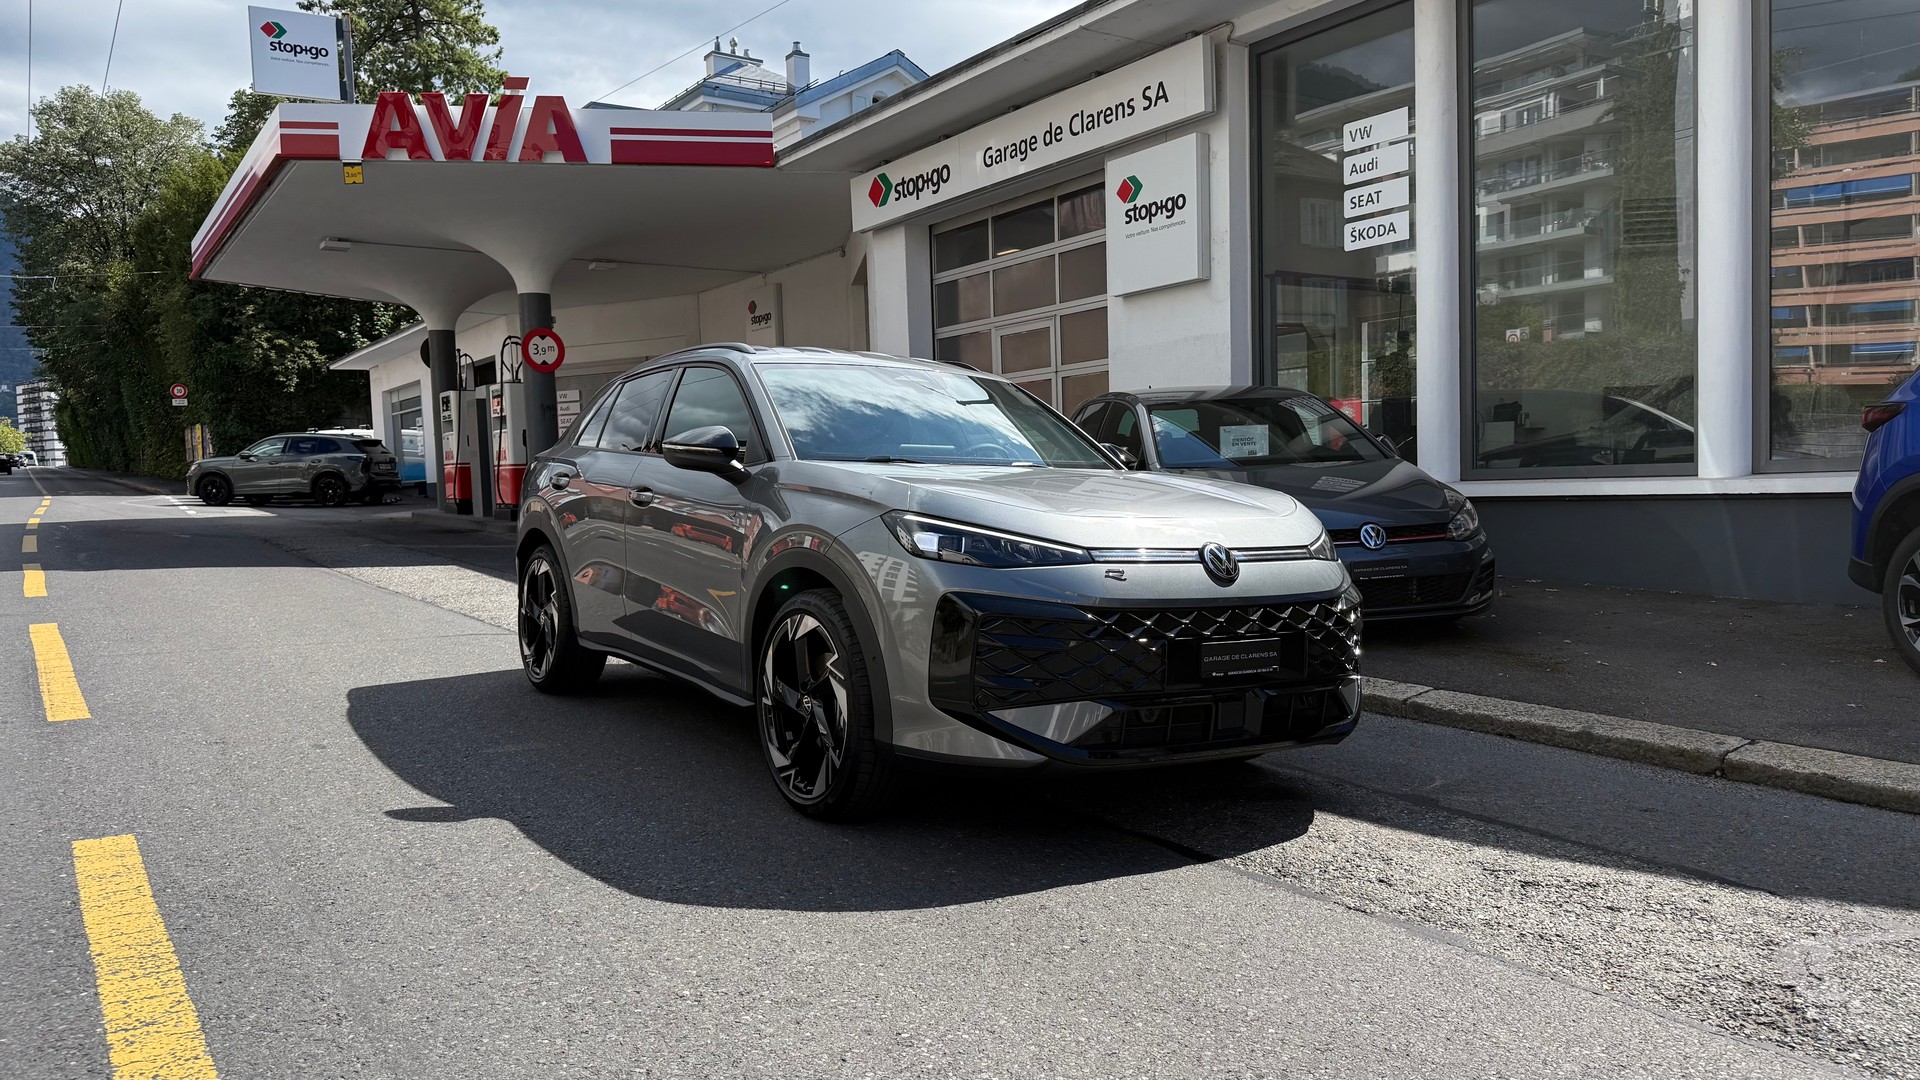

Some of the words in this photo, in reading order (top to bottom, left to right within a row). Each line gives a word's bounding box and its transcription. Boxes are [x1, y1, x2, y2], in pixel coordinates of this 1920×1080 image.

[269, 40, 329, 60] stop+go
[983, 135, 1038, 168] Garage
[1043, 122, 1063, 147] de
[1069, 97, 1136, 137] Clarens
[1142, 81, 1169, 111] SA
[1349, 124, 1373, 143] VW
[1349, 156, 1379, 177] Audi
[894, 164, 951, 202] stop+go
[1124, 193, 1187, 225] stop+go
[1350, 190, 1382, 210] SEAT
[1350, 221, 1397, 243] ŠKODA
[750, 312, 772, 326] stop+go
[1203, 654, 1231, 662] GARAGE
[1240, 651, 1269, 660] CLARENS
